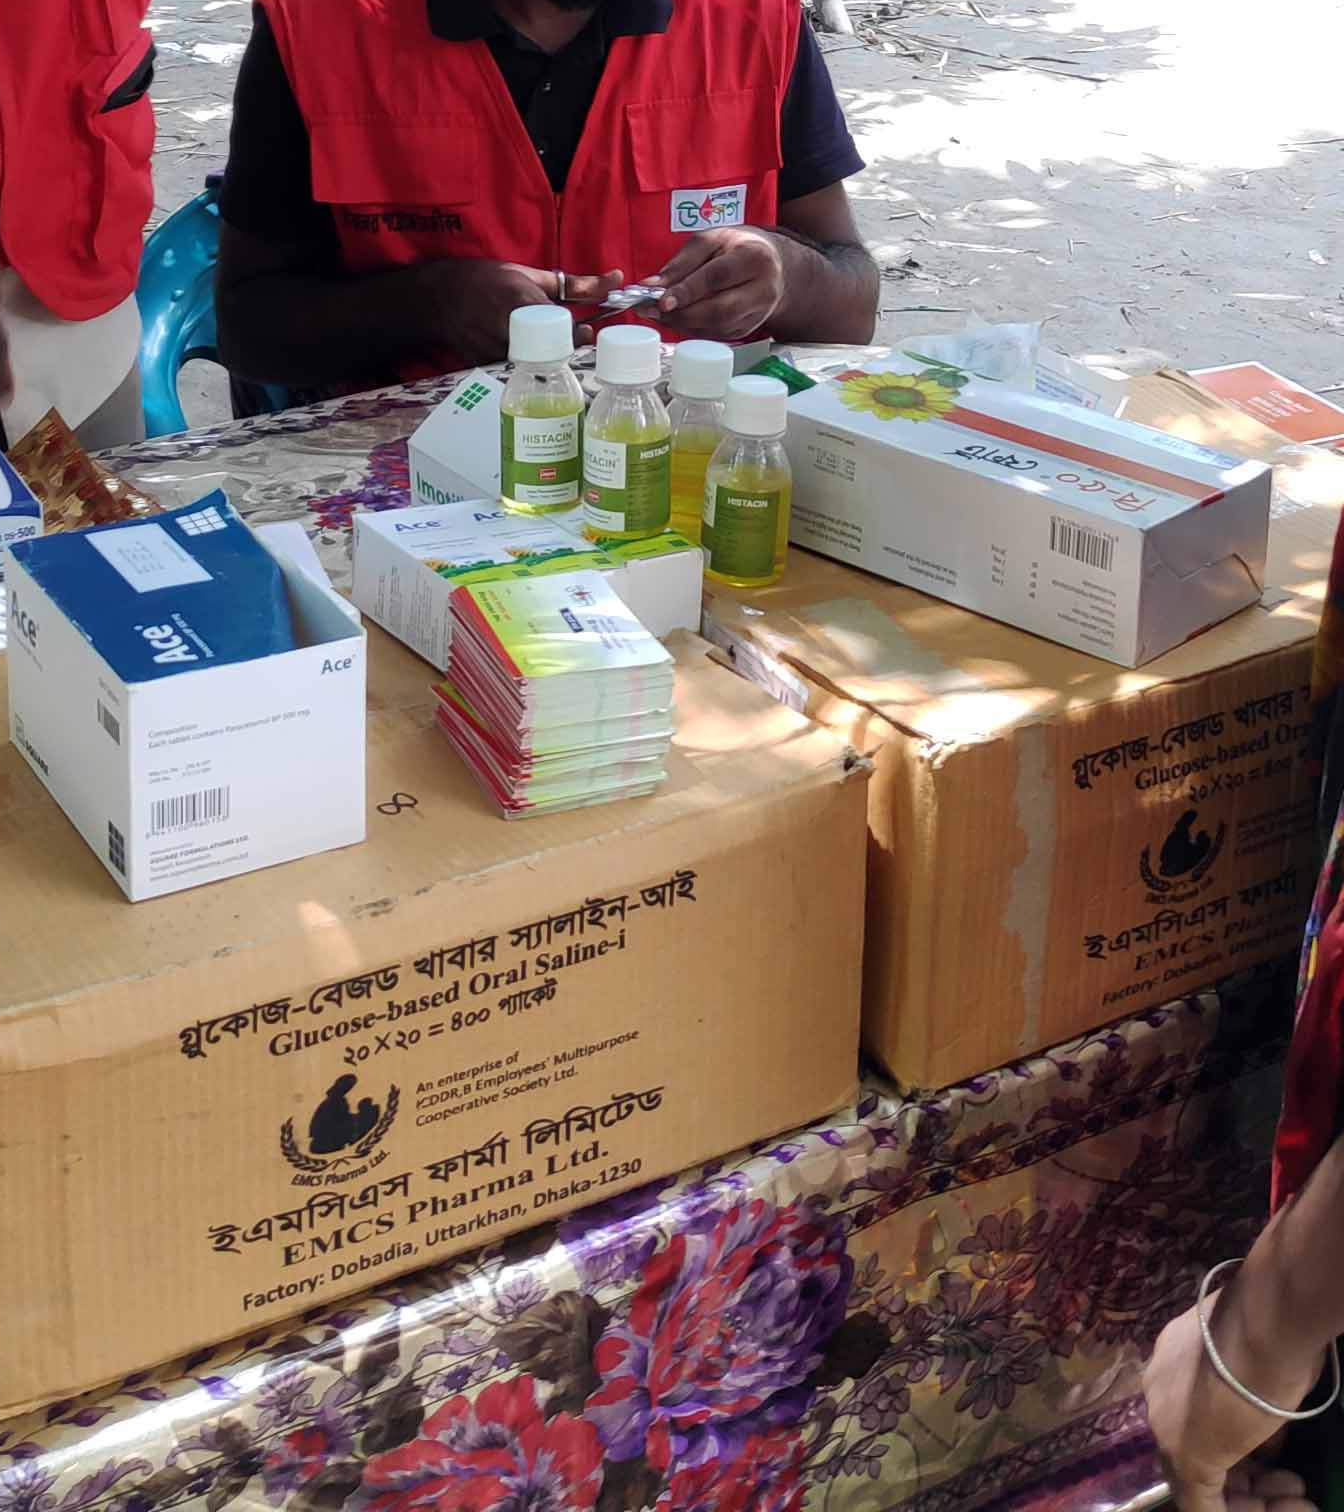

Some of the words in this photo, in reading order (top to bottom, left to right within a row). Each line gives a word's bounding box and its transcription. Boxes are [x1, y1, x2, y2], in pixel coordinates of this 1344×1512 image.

[522, 432, 573, 445] HISTACIN
[395, 520, 440, 532] Ace
[473, 511, 506, 522] Ac
[728, 496, 769, 508] HISTACIN
[10, 590, 38, 649] Ace
[140, 623, 200, 664] Ace
[321, 656, 354, 675] Ace
[1135, 729, 1270, 791] Glucose-based
[179, 964, 401, 1058] গ্লুকোজ-বেজড
[413, 935, 498, 980] খাবার
[508, 869, 698, 951] স্যালাইন-আই
[268, 980, 460, 1057] Glucose-based
[469, 959, 528, 995] Oral
[535, 928, 626, 976] Saline-i
[343, 1042, 370, 1066] ২০
[395, 1028, 422, 1051] ২০
[427, 1022, 445, 1037] =
[498, 977, 559, 1017] প্যাকেট
[416, 1081, 434, 1094] An
[437, 1059, 504, 1087] enterprise
[505, 1050, 521, 1066] of
[553, 1029, 641, 1066] Multipurpose
[416, 1092, 500, 1127] Cooperative
[502, 1075, 552, 1100] Society
[554, 1064, 579, 1082] Ltd.
[208, 1172, 414, 1255] ইএমসিএস
[424, 1131, 511, 1183] ফার্মা
[520, 1086, 665, 1155] লিমিটেড
[290, 1173, 323, 1187] EMCS
[325, 1165, 369, 1185] Pharma
[369, 1149, 391, 1169] Ltd.
[282, 1212, 396, 1268] EMCS
[407, 1169, 534, 1225] Pharma
[545, 1141, 609, 1177] Ltd.
[242, 1273, 325, 1311] Factory:
[331, 1243, 419, 1282] Dobadia,
[425, 1202, 528, 1247] Uttarkhan,
[533, 1158, 643, 1209] Dhaka-1230
